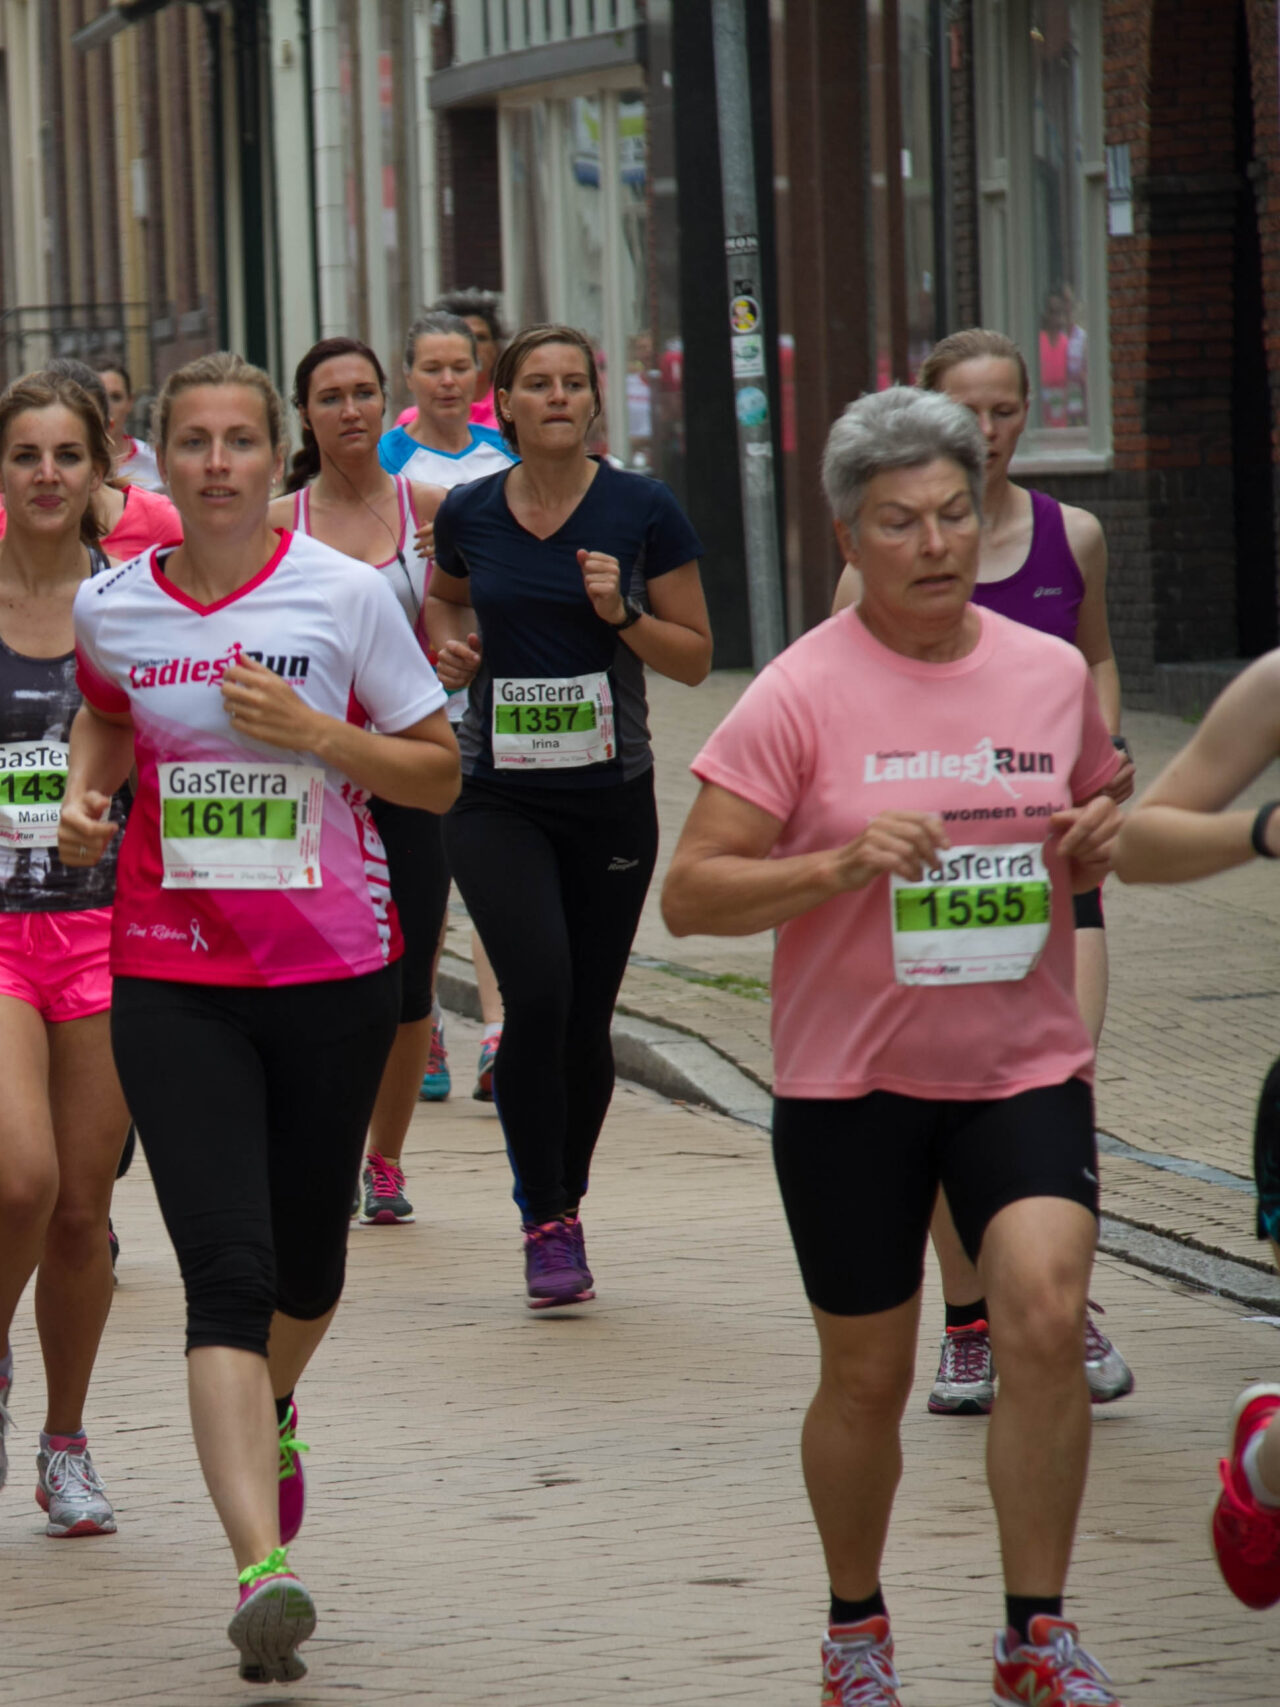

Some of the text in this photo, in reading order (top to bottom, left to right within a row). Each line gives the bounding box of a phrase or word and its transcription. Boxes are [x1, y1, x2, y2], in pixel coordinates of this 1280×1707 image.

[129, 656, 226, 689] Ladies
[501, 682, 584, 702] GasTerra
[510, 707, 578, 732] 1357
[532, 739, 560, 749] Irina
[864, 748, 1054, 783] Ladies Run
[1, 773, 66, 803] 143
[170, 767, 287, 796] GasTerra
[18, 810, 62, 823] Marië
[181, 801, 268, 836] 1611
[942, 806, 1016, 822] women
[926, 854, 1033, 881] asTerra
[921, 886, 1026, 927] 1555
